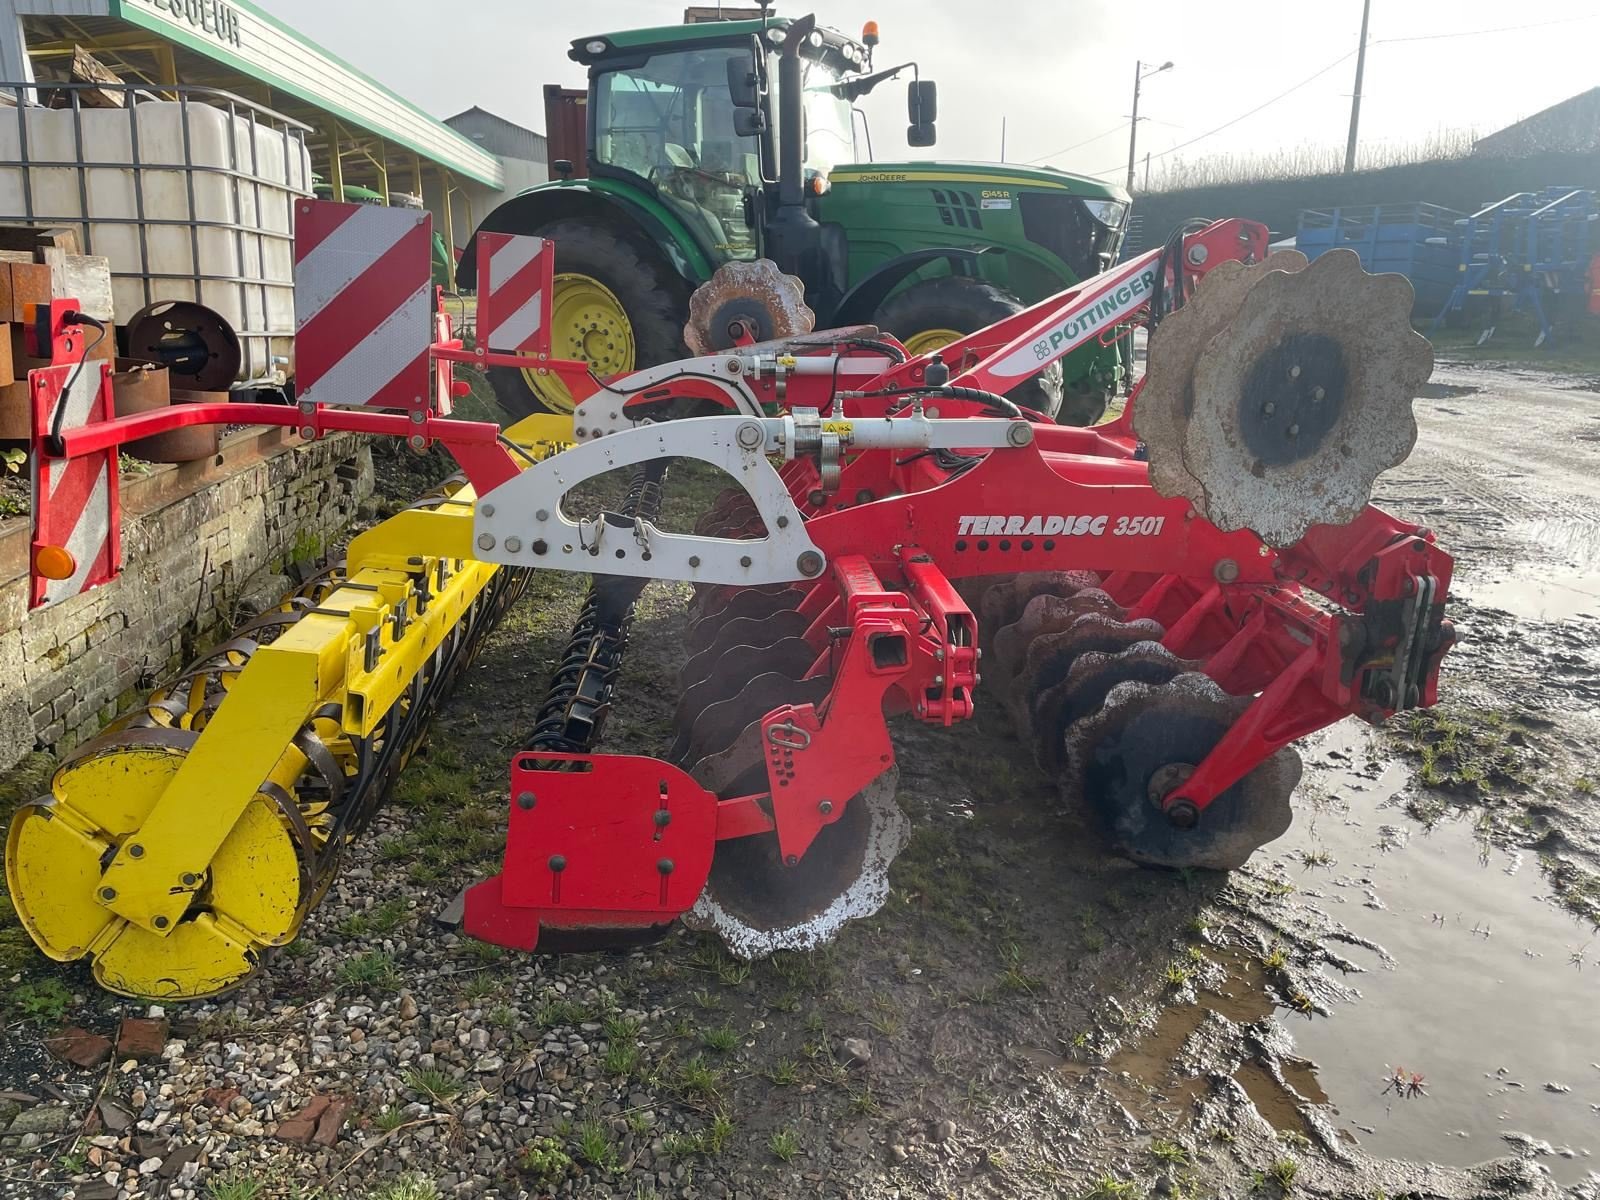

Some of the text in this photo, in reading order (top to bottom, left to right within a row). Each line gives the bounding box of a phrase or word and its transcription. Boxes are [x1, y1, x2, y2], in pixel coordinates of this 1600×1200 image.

[858, 173, 907, 182] JOHN DEERE
[1048, 270, 1154, 351] PÖTTINGER
[957, 515, 1166, 536] TERRADISC 3501
